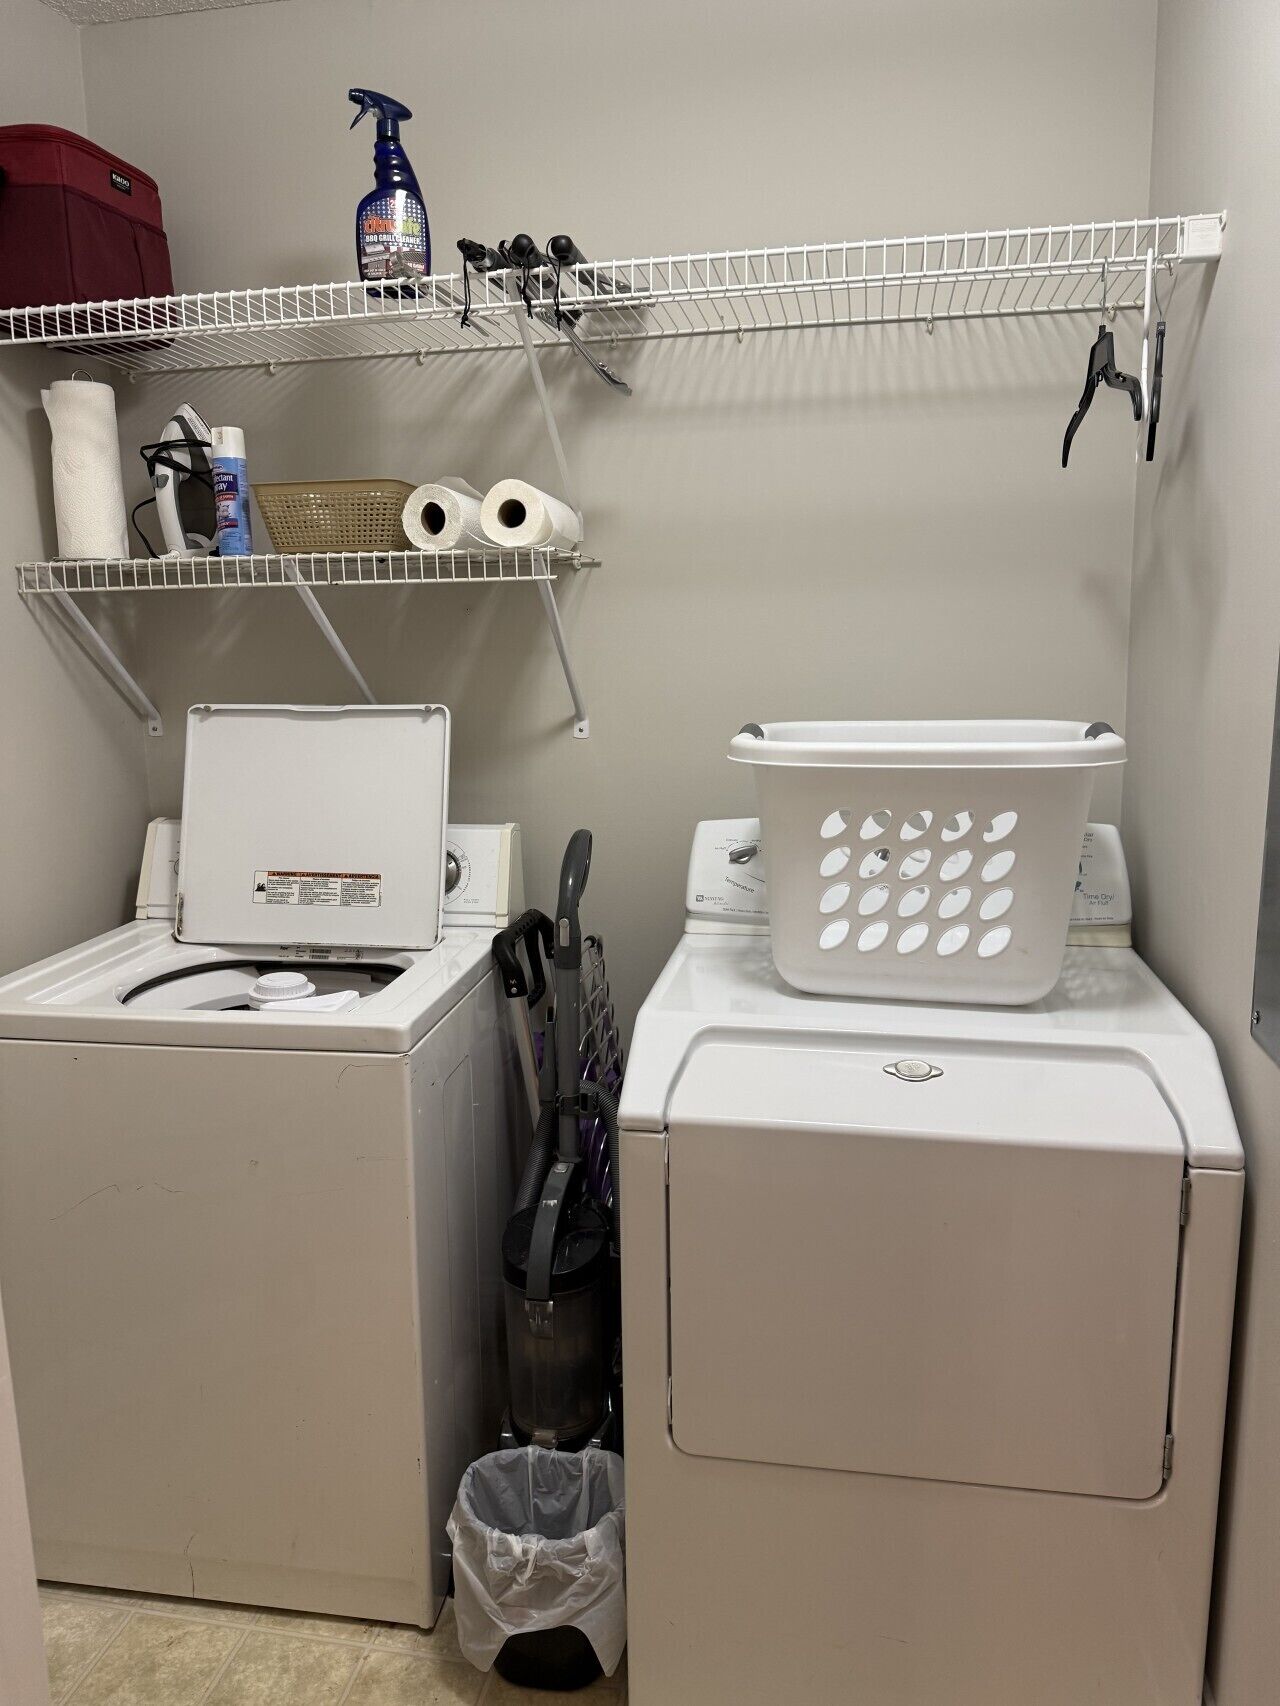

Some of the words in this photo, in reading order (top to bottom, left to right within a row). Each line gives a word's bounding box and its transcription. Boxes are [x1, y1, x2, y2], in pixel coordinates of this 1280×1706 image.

[365, 234, 378, 243] BBQ
[379, 234, 395, 242] GRILL
[724, 876, 755, 893] Temperature
